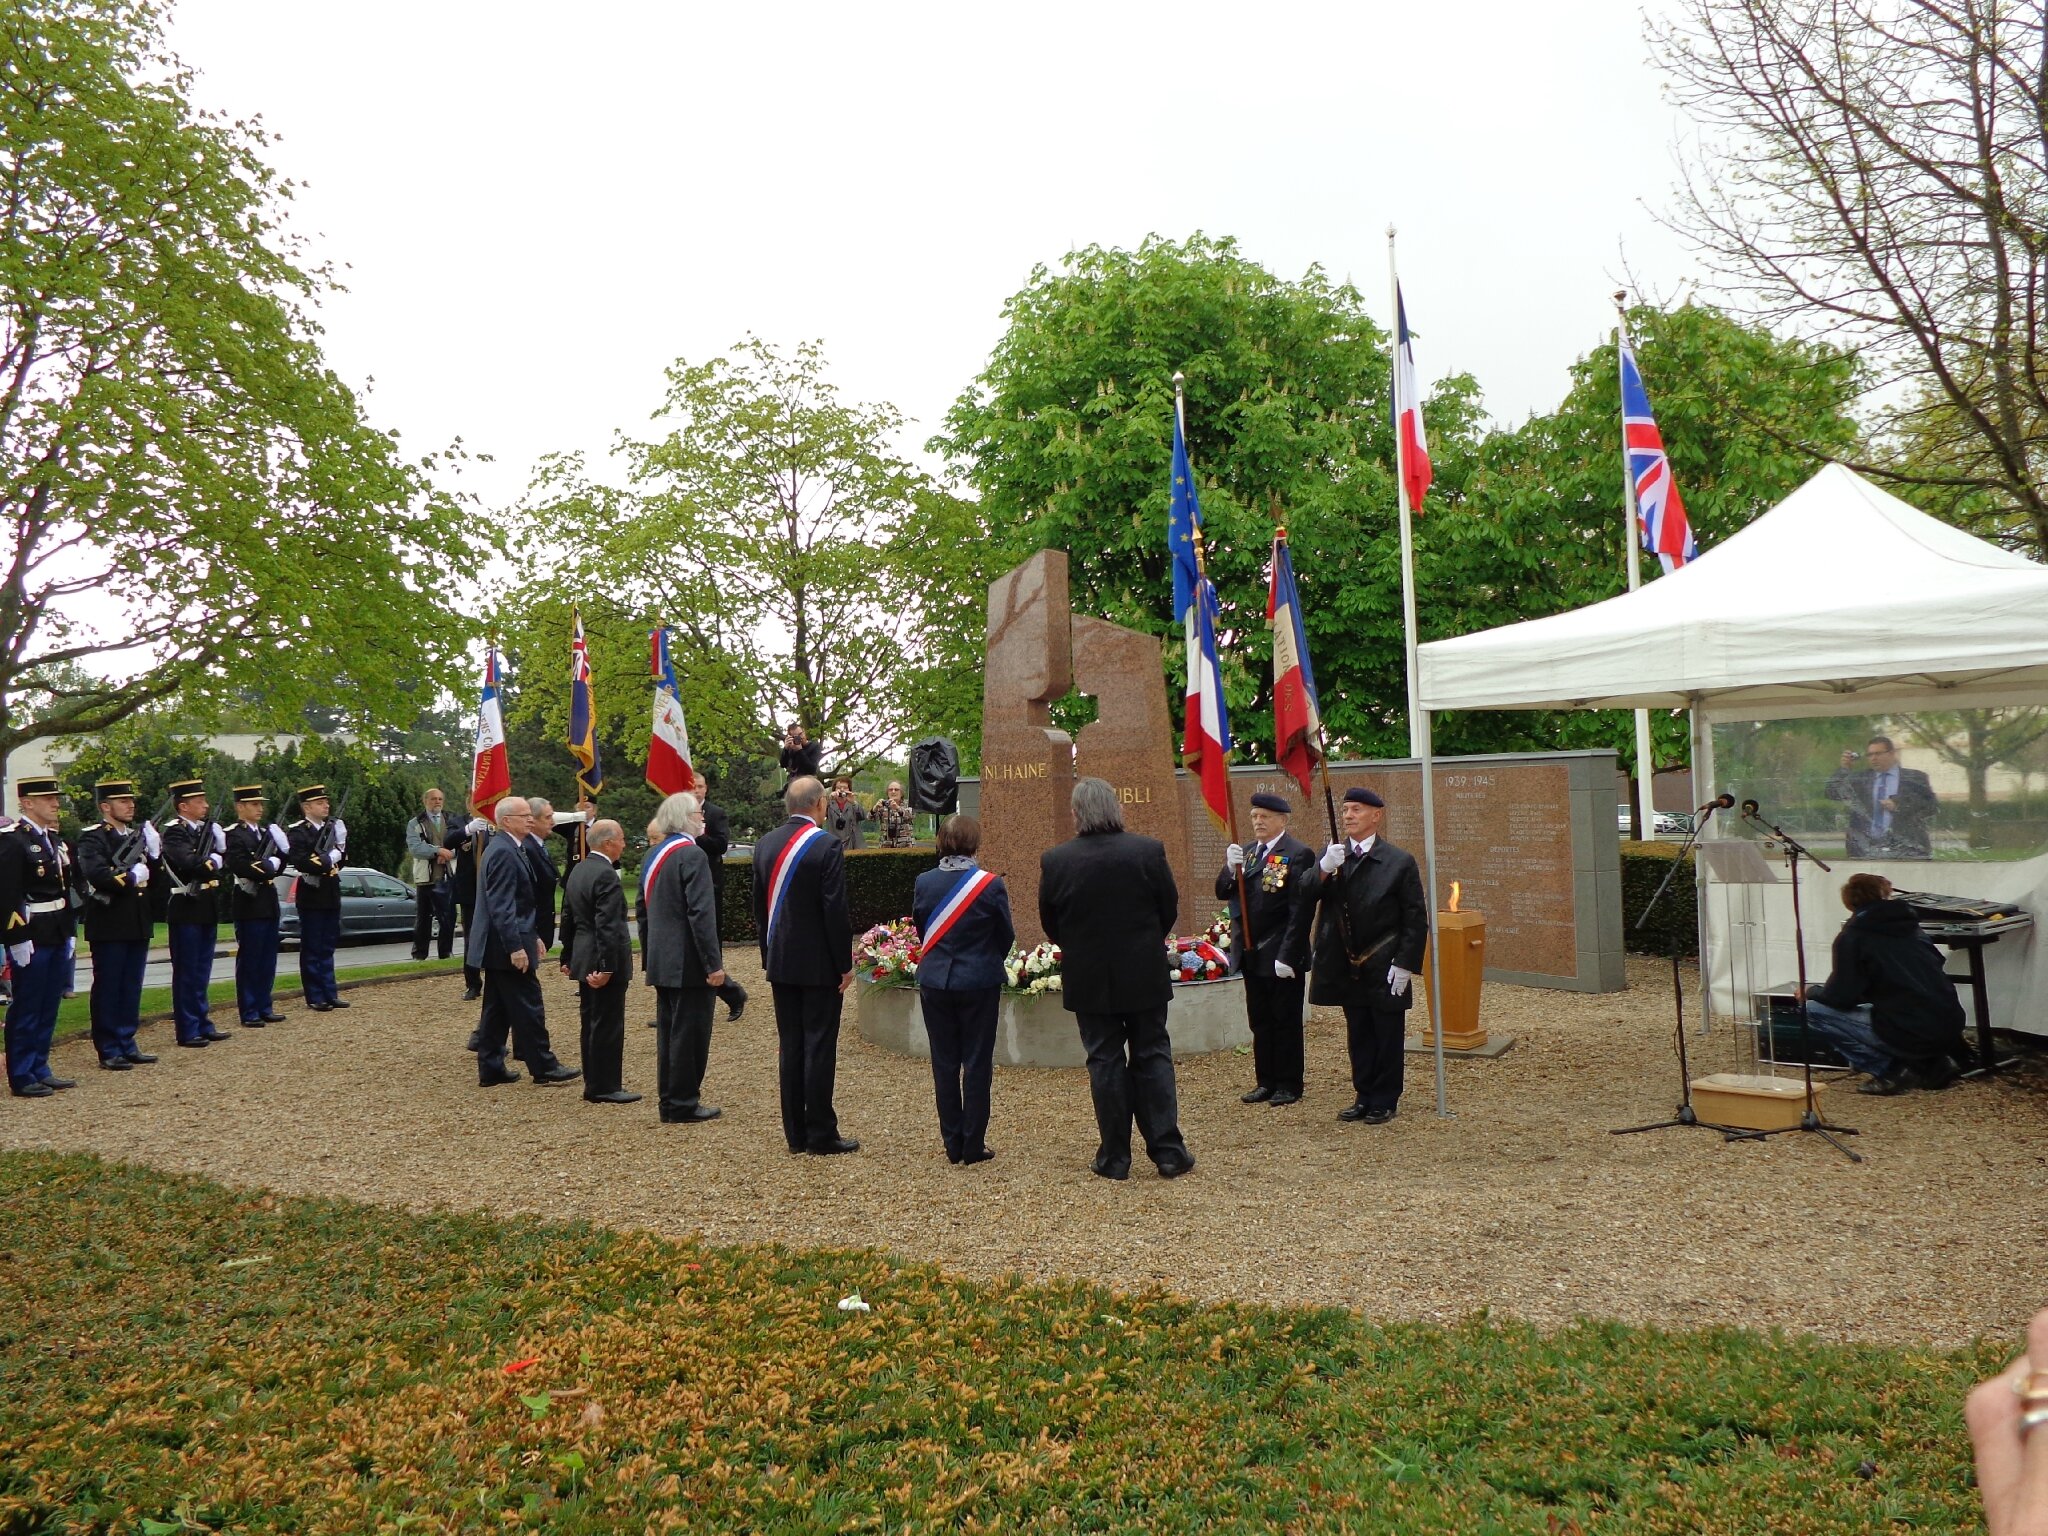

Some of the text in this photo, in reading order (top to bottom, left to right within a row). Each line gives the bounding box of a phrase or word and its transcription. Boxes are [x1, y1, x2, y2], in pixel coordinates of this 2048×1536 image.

[476, 737, 493, 788] COMBATTAN
[985, 762, 1047, 780] NI HAINE
[1256, 782, 1276, 793] 1914
[1445, 774, 1496, 787] 1939 1945
[1113, 786, 1151, 804] UBLI
